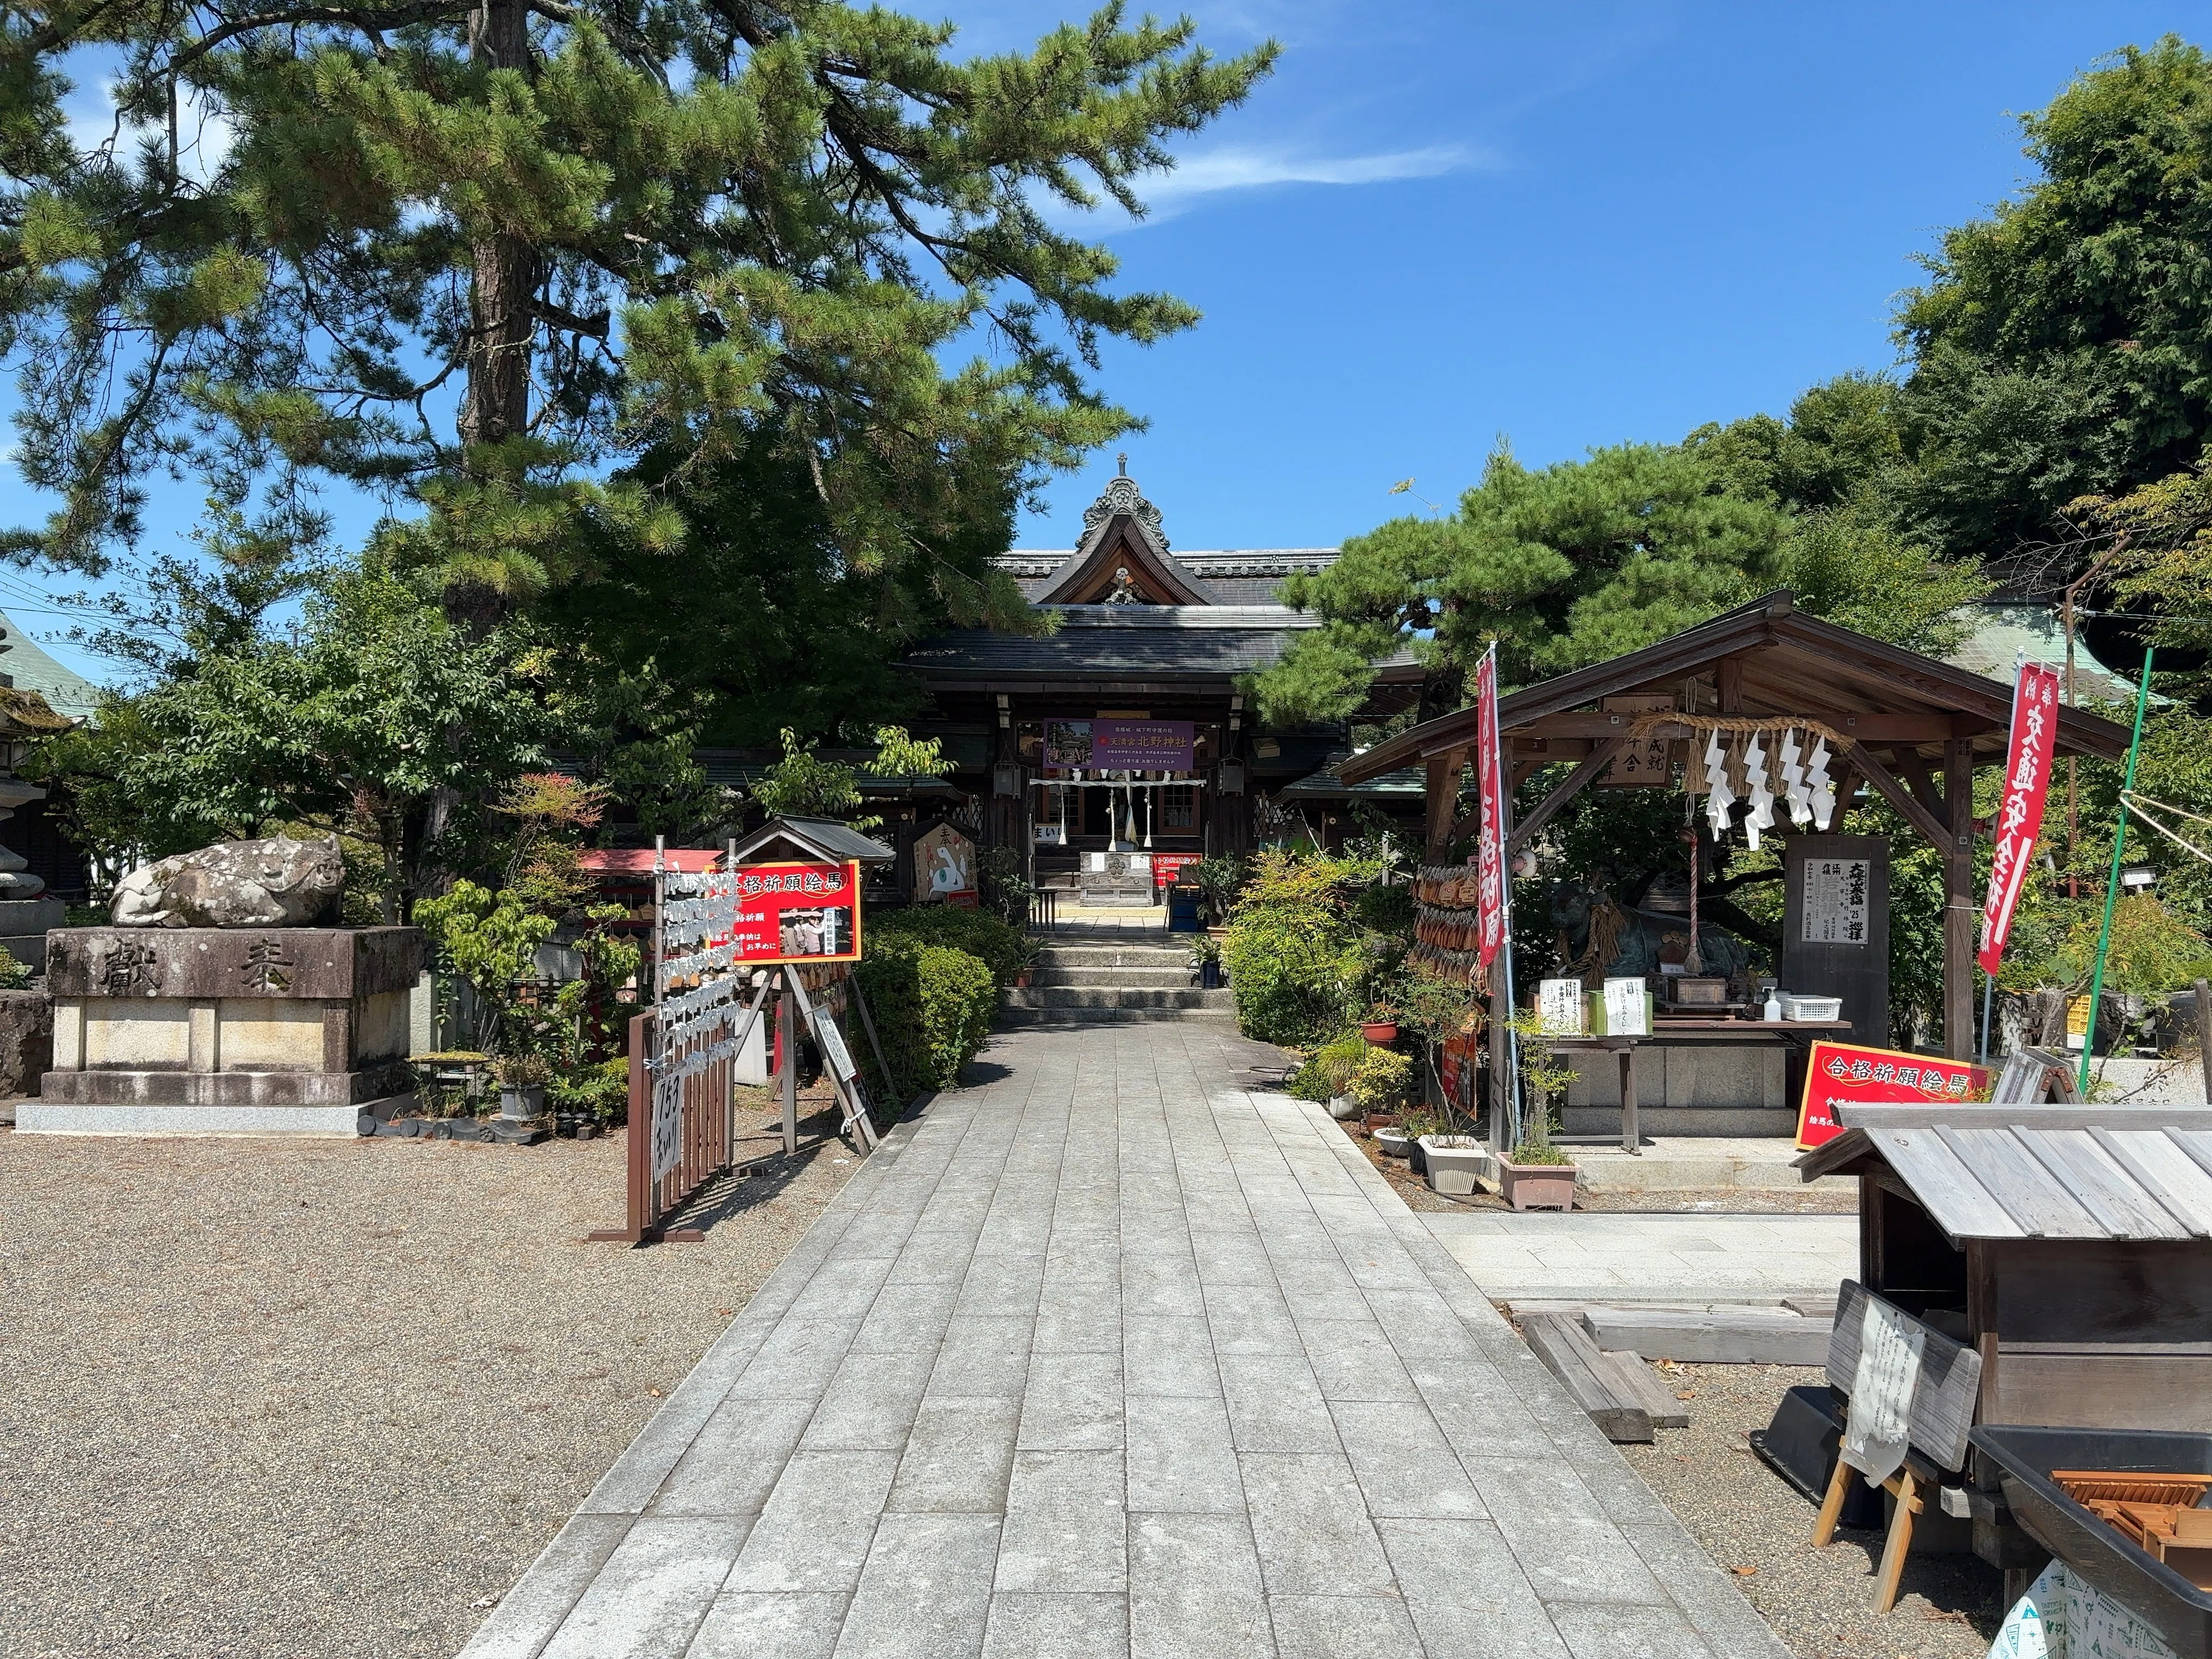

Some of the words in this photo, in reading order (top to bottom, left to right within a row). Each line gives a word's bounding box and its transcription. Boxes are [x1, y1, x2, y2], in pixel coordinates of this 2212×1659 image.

[1110, 737, 1136, 746] 天満宮
[1137, 736, 1188, 748] 北野神社
[736, 912, 765, 923] 格祈願
[1848, 921, 1863, 941] 巡拝
[746, 943, 777, 951] お早めに
[1619, 986, 1627, 1027] 手受けおみくじ
[1827, 1055, 1970, 1094] 合格祈願絵馬
[659, 1075, 680, 1122] 753
[657, 1115, 677, 1170] まいり
